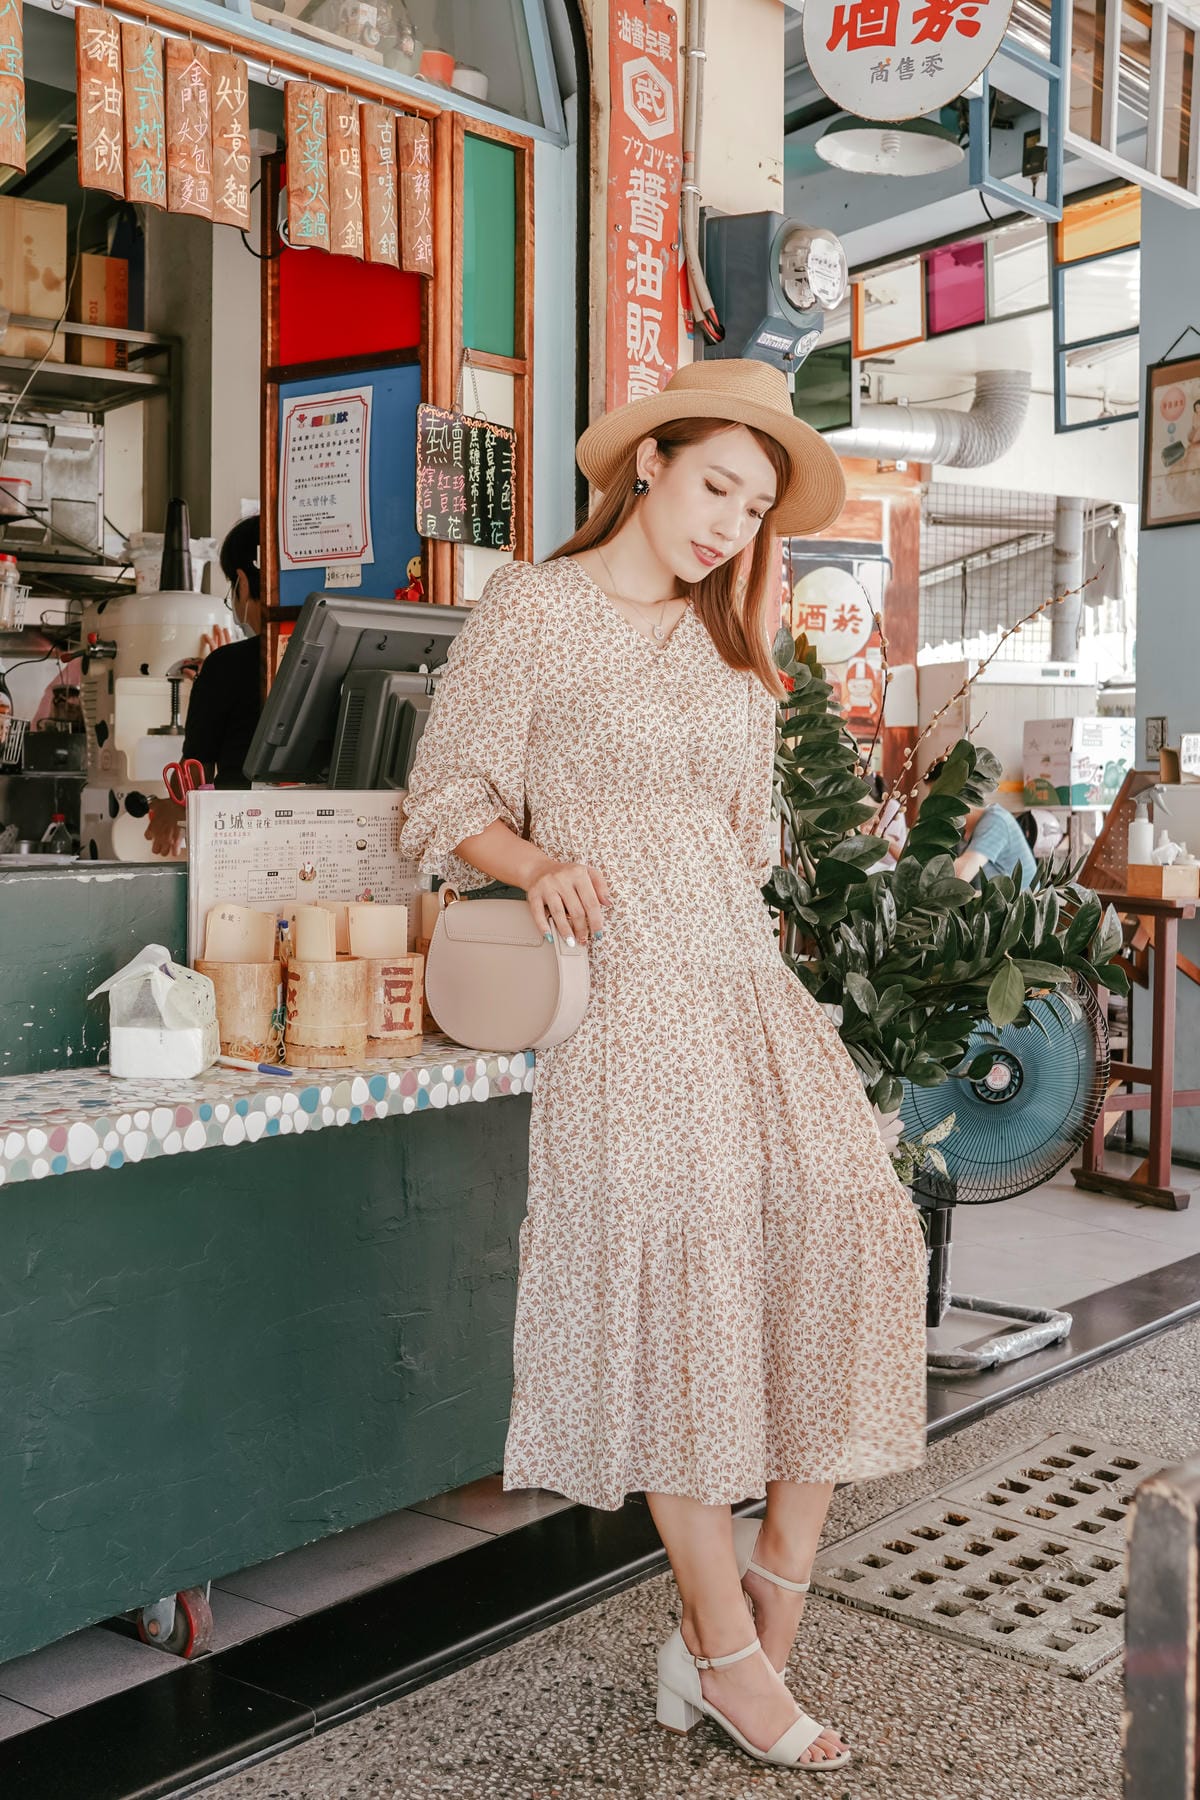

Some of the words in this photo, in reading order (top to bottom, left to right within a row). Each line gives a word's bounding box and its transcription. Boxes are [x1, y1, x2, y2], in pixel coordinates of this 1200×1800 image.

[82, 28, 124, 177] 豬油飯
[127, 43, 165, 200] 各式炸物
[177, 58, 212, 214] 金門炒泡麵
[215, 75, 249, 218] 炒意麵
[295, 99, 329, 243] 泡菜火鍋
[339, 114, 363, 250] 咖哩火鍋
[377, 121, 398, 261] 古早味火鍋
[408, 135, 432, 264] 麻辣火鍋
